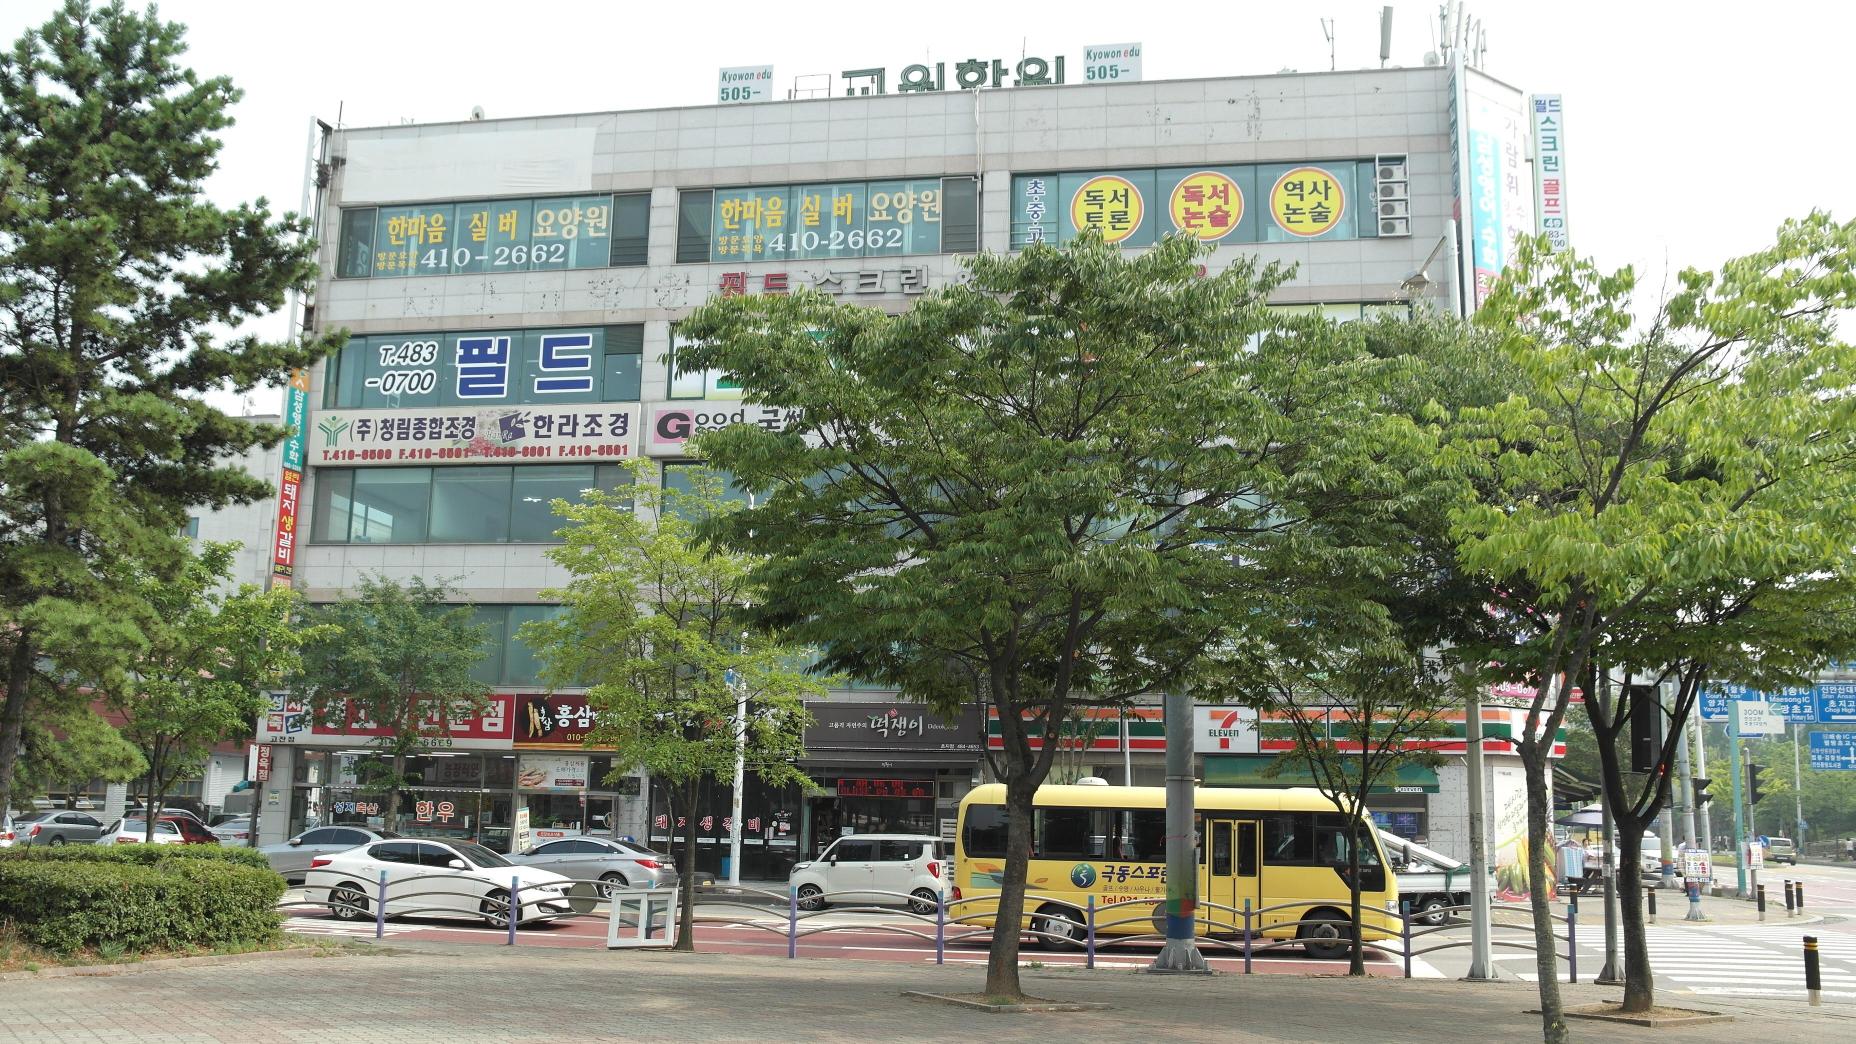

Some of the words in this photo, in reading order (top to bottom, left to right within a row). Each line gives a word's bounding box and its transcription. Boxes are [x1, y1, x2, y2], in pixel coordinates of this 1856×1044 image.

[1086, 49, 1121, 60] Kyowon
[1123, 46, 1140, 57] edu
[721, 70, 754, 82] Kyowon
[756, 69, 772, 80] edu
[1086, 65, 1130, 80] 505-
[720, 86, 761, 101] 505-
[1535, 99, 1561, 113] 필드
[1540, 116, 1559, 172] 스크린
[1083, 188, 1129, 210] 독서
[1182, 183, 1231, 206] 독서
[1283, 180, 1332, 201] 역사
[1543, 178, 1561, 214] 골프
[720, 195, 784, 230] 한마음
[868, 189, 942, 225] 요양원
[1084, 210, 1131, 232] 토론
[1182, 205, 1232, 228] 논술
[1283, 201, 1332, 224] 논술
[388, 213, 447, 246] 한마음
[532, 205, 609, 240] 요양원
[768, 228, 904, 251] 410-2662
[420, 243, 566, 268] 410-2662
[816, 264, 930, 295] 스크린
[380, 341, 438, 366] T.483
[455, 333, 594, 399] 필드
[366, 369, 437, 395] -0700
[533, 412, 630, 439] 한라조경
[278, 484, 298, 565] 돼지생갈비
[1821, 686, 1856, 695] 신안산대
[867, 713, 923, 739] 떡쟁이
[260, 746, 271, 781] 정육점
[415, 800, 456, 823] 한우
